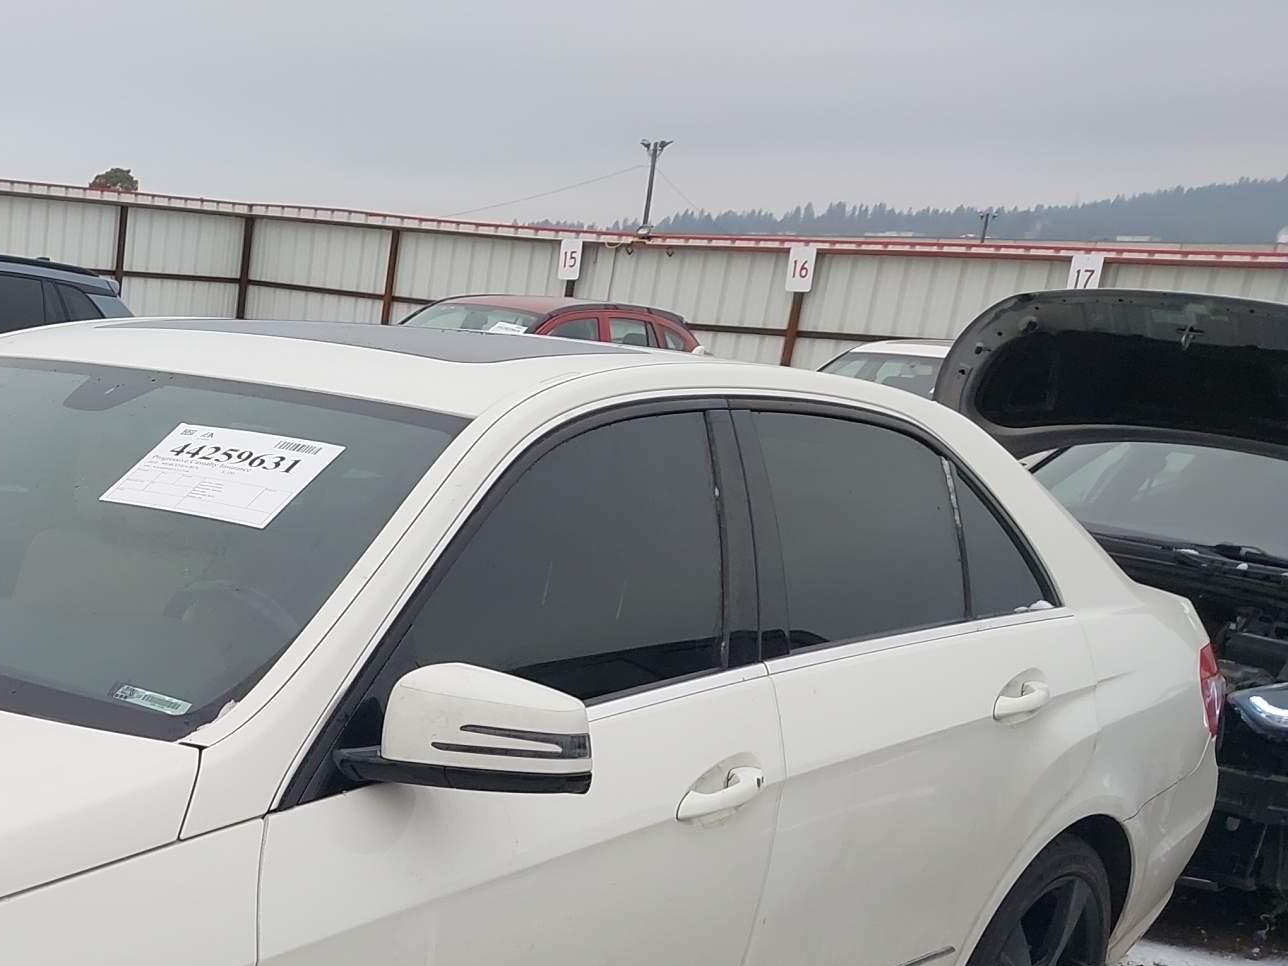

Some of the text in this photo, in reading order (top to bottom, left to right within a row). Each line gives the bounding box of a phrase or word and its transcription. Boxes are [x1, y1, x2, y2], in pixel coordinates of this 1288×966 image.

[563, 251, 577, 268] 15
[792, 259, 808, 278] 16
[1073, 269, 1096, 289] 17
[169, 442, 302, 474] 44259631
